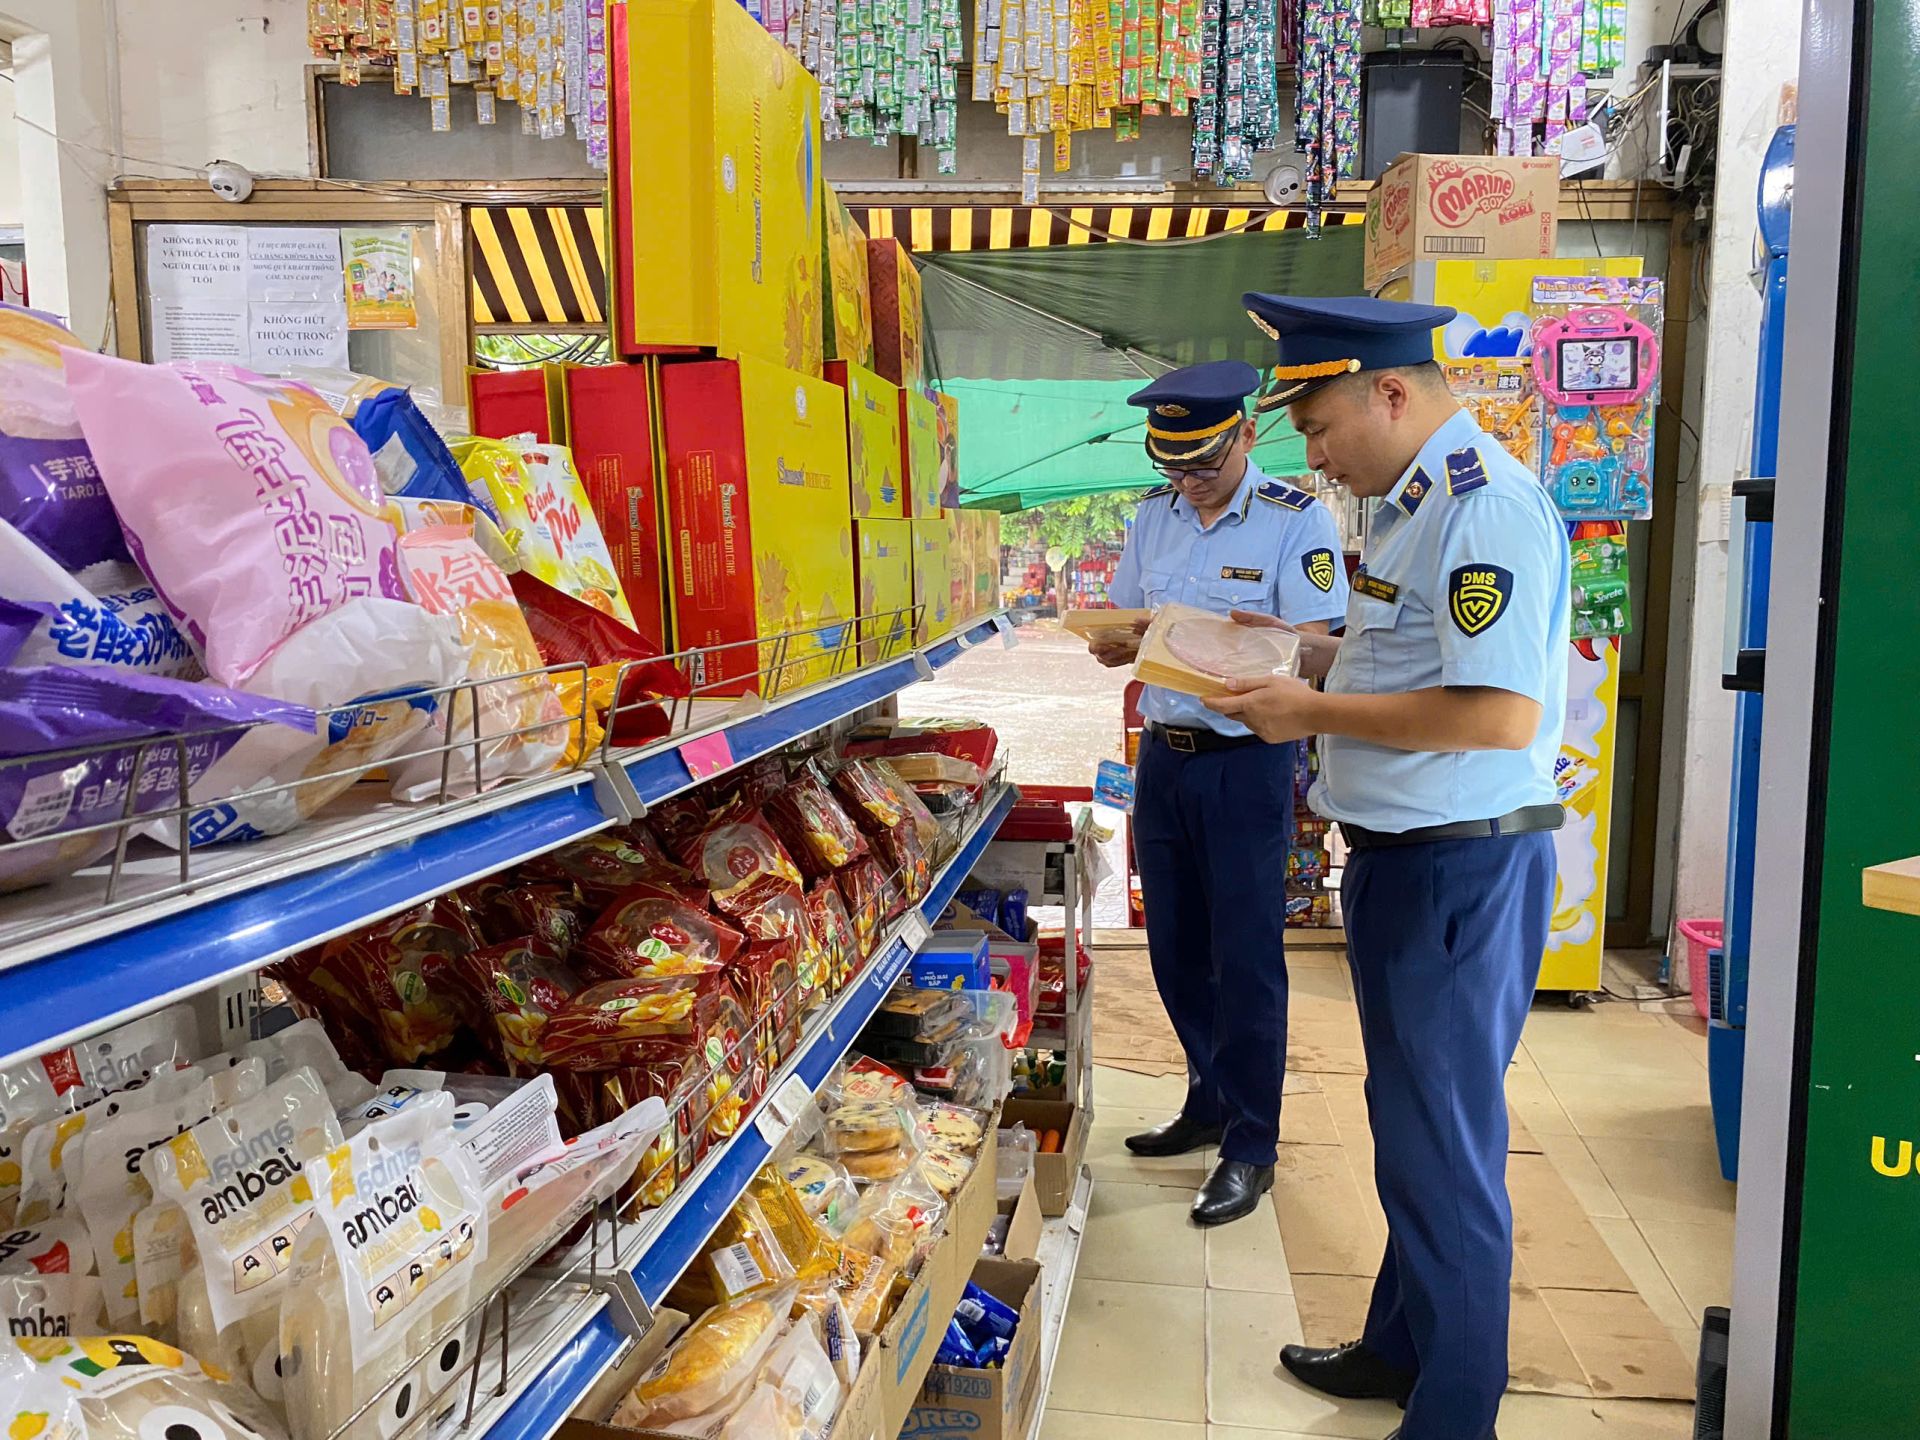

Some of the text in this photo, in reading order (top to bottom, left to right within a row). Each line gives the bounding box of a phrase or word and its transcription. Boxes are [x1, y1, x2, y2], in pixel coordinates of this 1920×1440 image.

[1480, 197, 1505, 213] BOY
[163, 235, 193, 245] KHÔNG
[177, 249, 206, 258] THUỐC
[221, 251, 240, 259] CHO
[263, 314, 326, 324] KHÔNG HÚT
[256, 330, 333, 340] THUỐC TRONG
[268, 345, 324, 356] CỬA HÀNG
[60, 486, 95, 501] TARO
[1312, 553, 1330, 563] DMS
[1462, 572, 1497, 585] DMS
[1871, 1136, 1920, 1178] U
[201, 1147, 302, 1224] ambai
[342, 1174, 424, 1249] ambai
